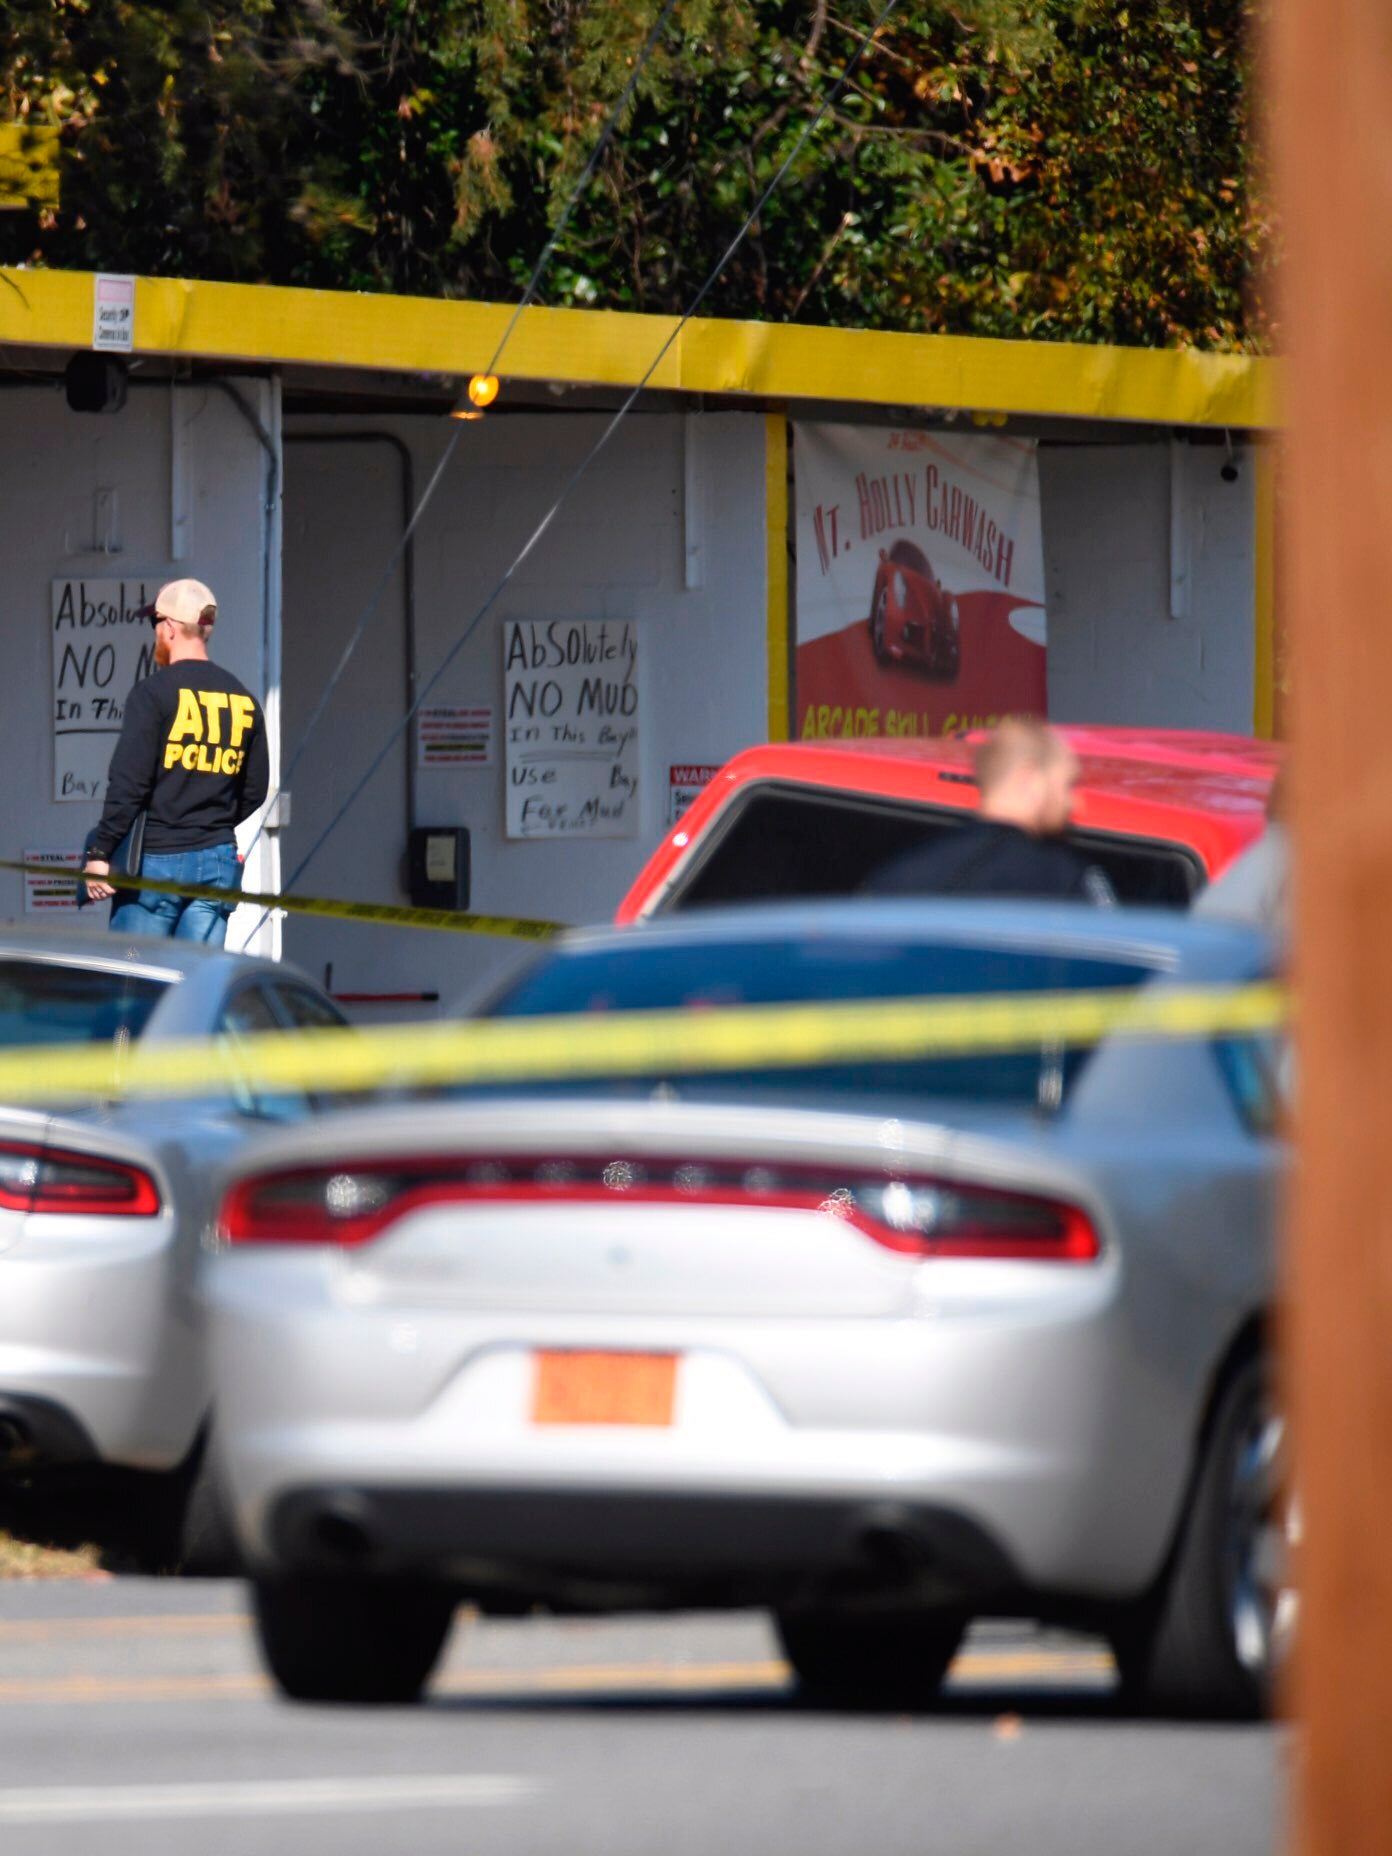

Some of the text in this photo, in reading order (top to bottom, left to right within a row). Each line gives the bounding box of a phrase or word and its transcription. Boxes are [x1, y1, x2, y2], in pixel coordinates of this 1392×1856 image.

[926, 463, 1014, 587] CARWASH
[55, 582, 150, 631] Absolut
[59, 643, 116, 689] NO
[56, 698, 125, 721] In Thi
[168, 688, 256, 747] ATF
[509, 680, 562, 719] NO
[509, 725, 540, 743] In
[552, 723, 586, 744] This
[800, 704, 880, 739] ARCADE
[62, 771, 100, 797] Bay
